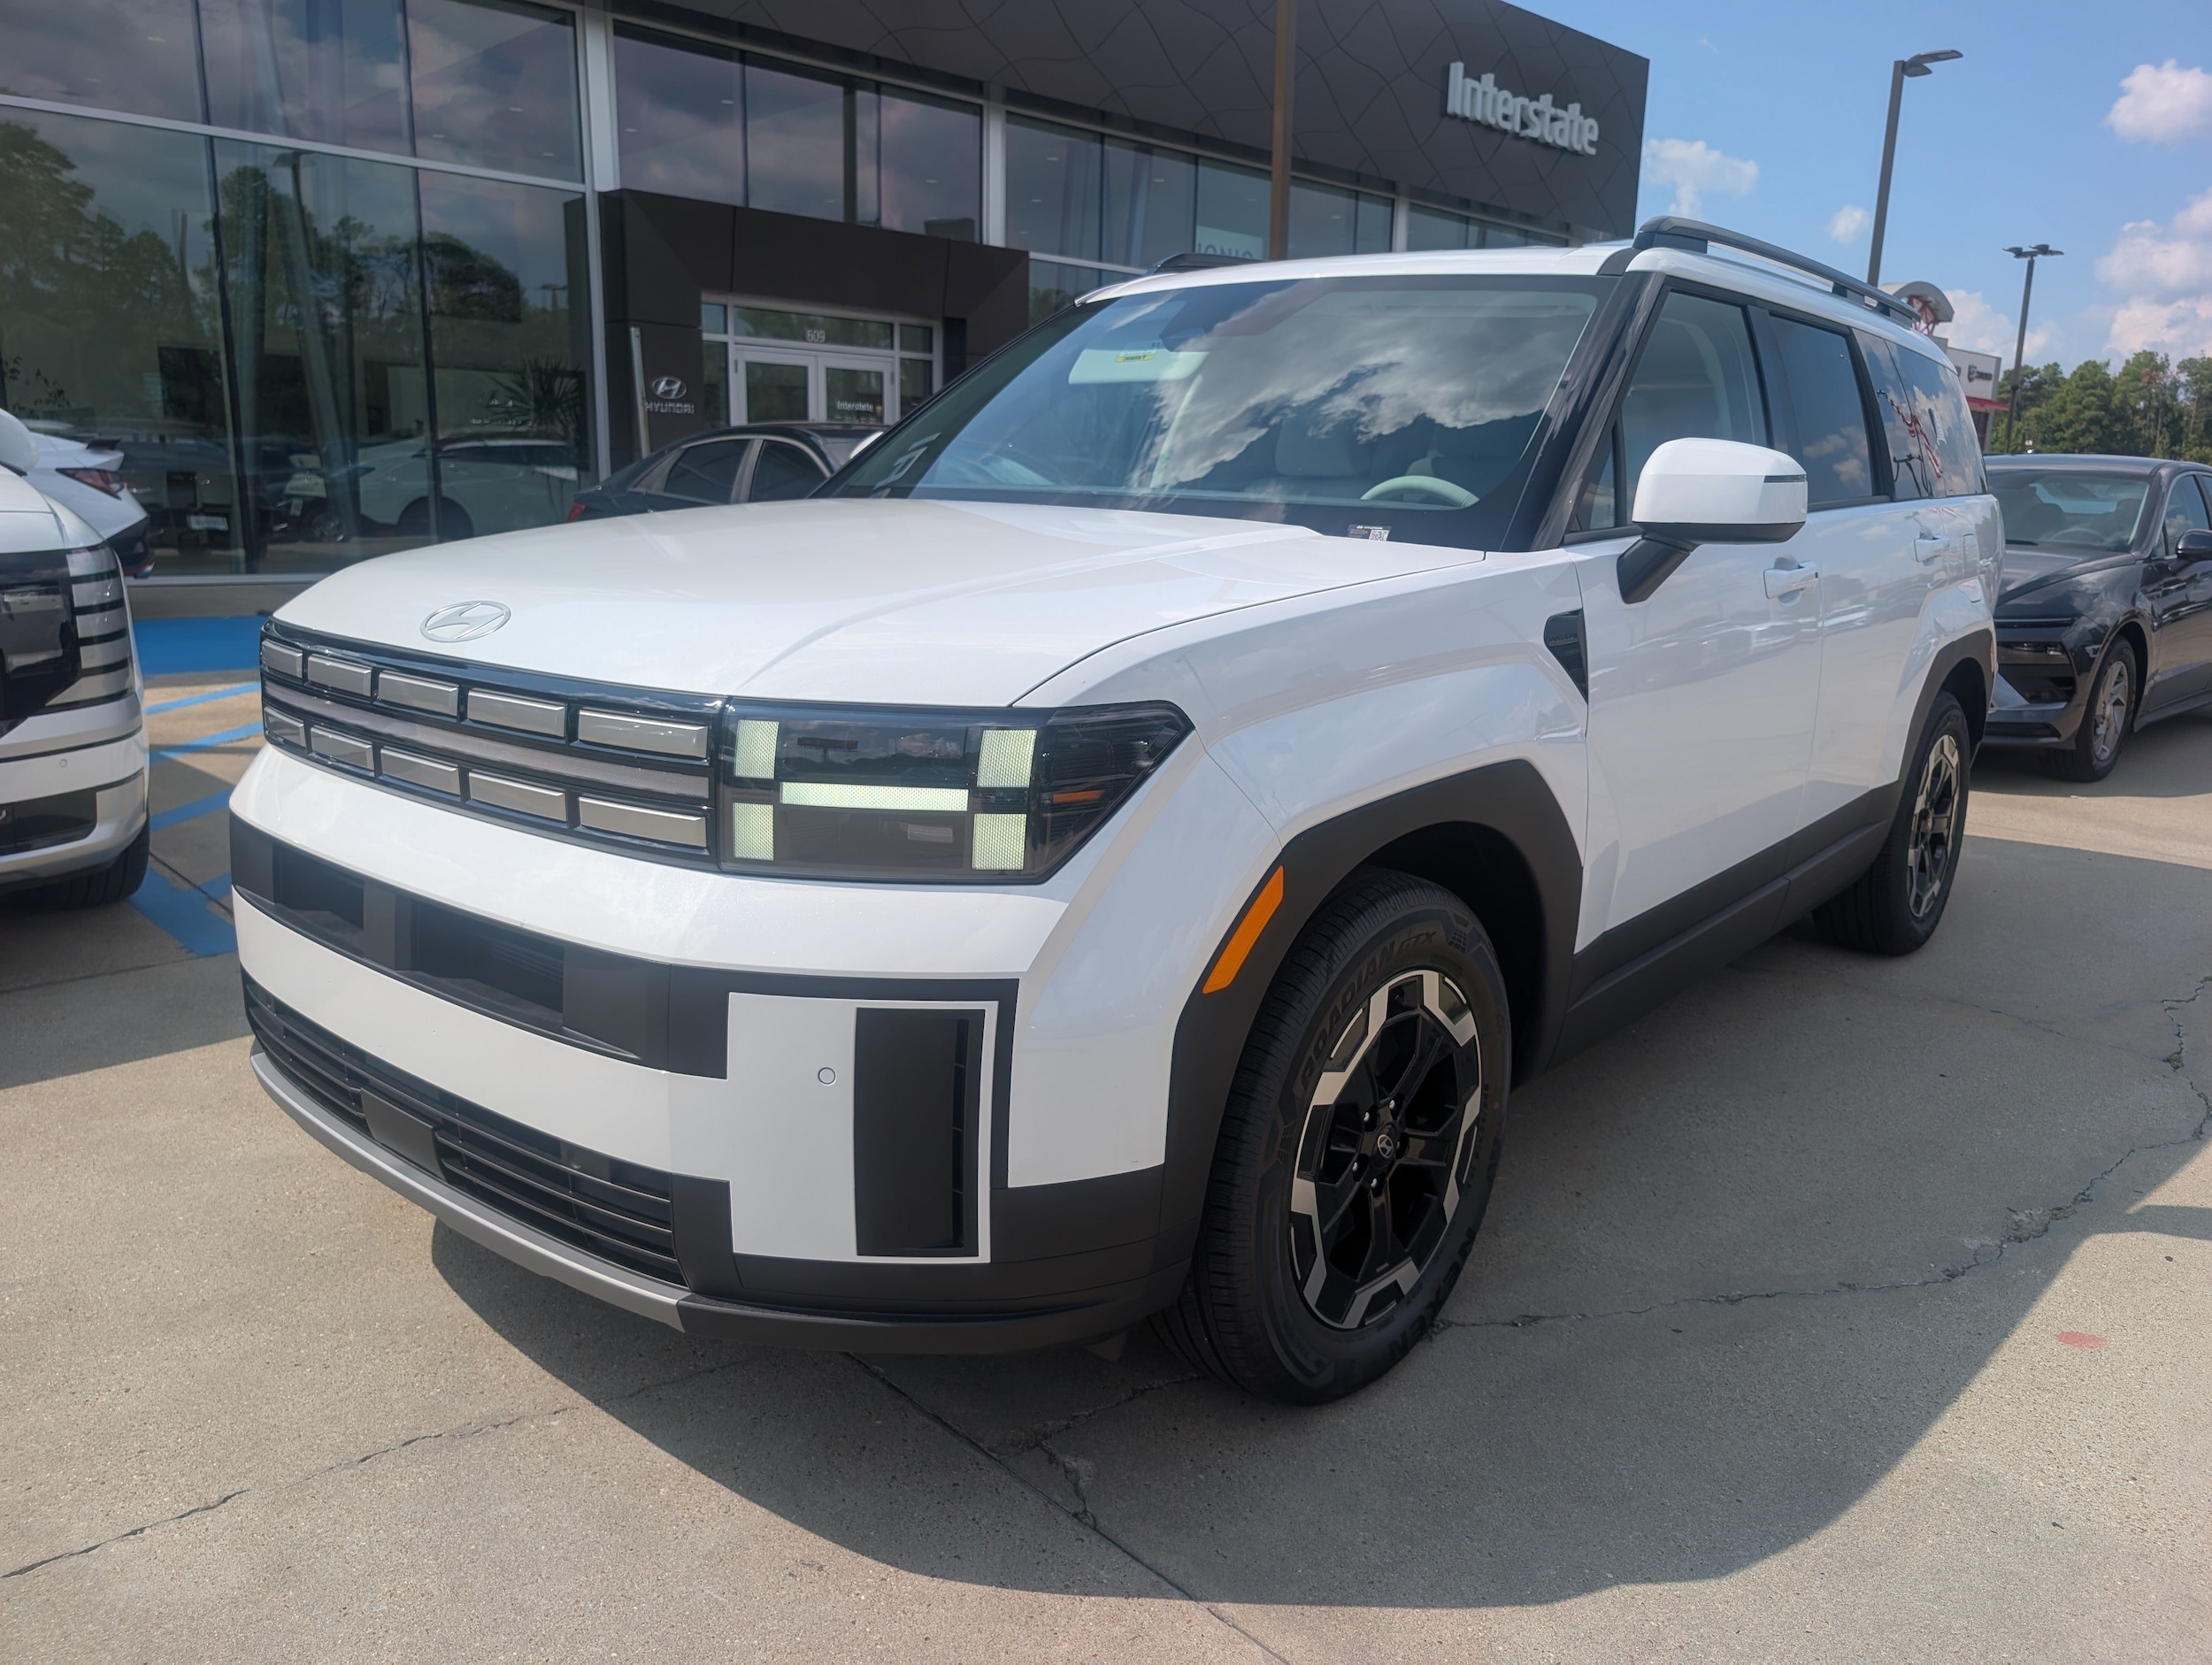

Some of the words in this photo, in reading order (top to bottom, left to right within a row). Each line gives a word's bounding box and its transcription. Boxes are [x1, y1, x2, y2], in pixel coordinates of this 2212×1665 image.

[1447, 61, 1599, 156] Interstate
[807, 329, 826, 342] 609
[645, 401, 695, 415] HYUNDAI
[1301, 940, 1395, 1091] ROADIAN
[1397, 931, 1437, 956] GTX
